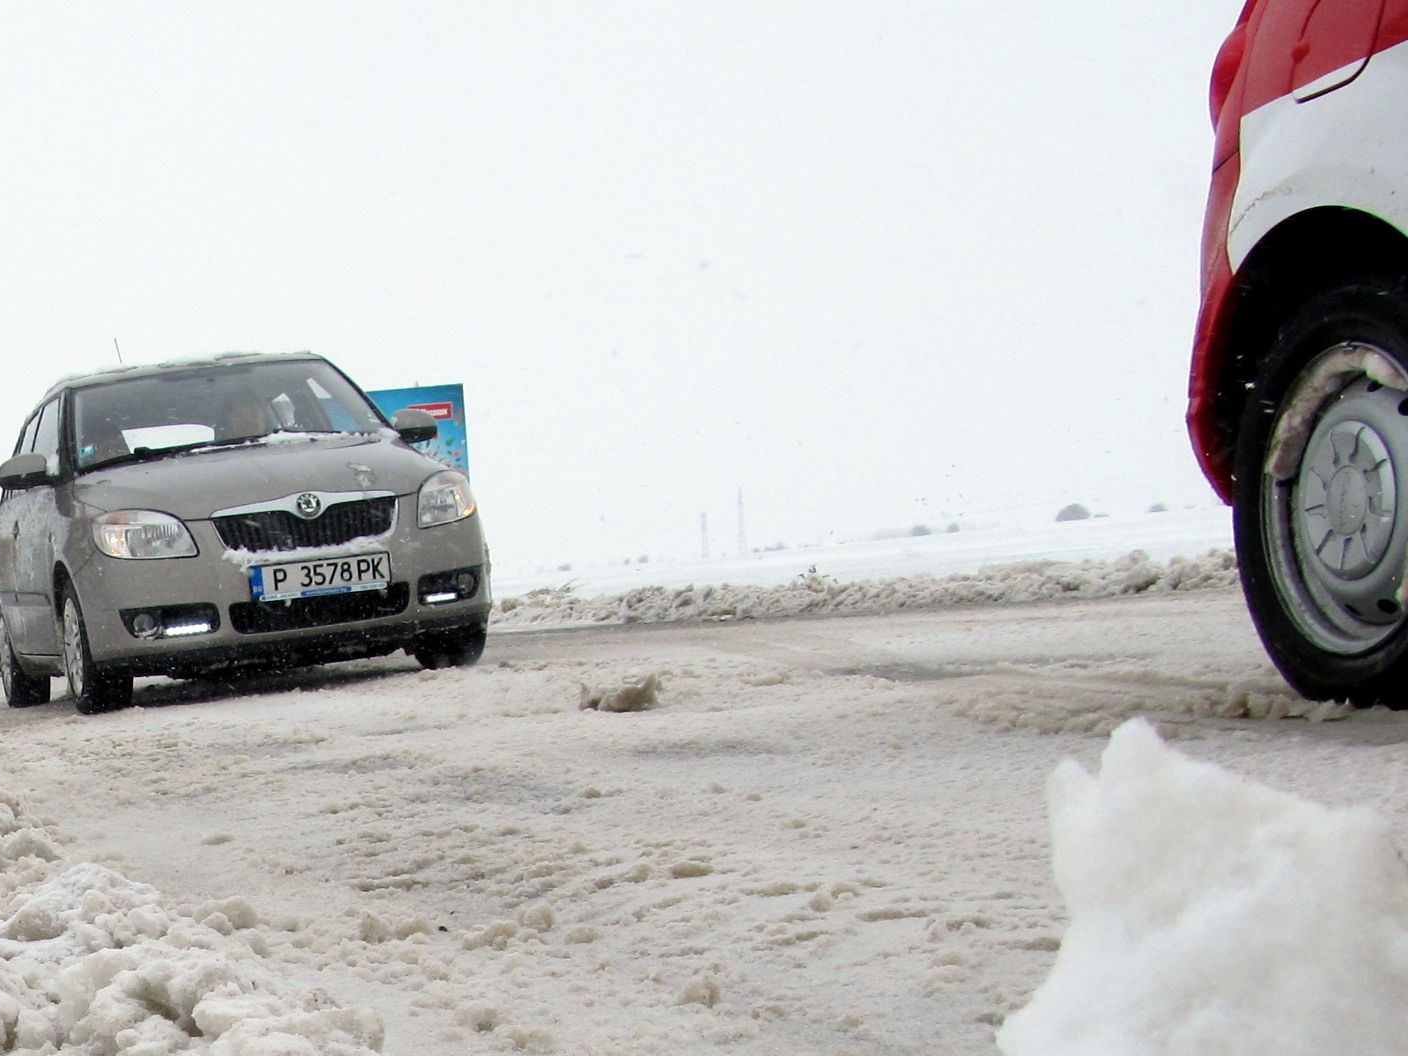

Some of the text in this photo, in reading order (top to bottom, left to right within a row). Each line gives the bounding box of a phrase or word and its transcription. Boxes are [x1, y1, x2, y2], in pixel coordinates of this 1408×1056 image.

[273, 557, 386, 591] P 3578 PK
